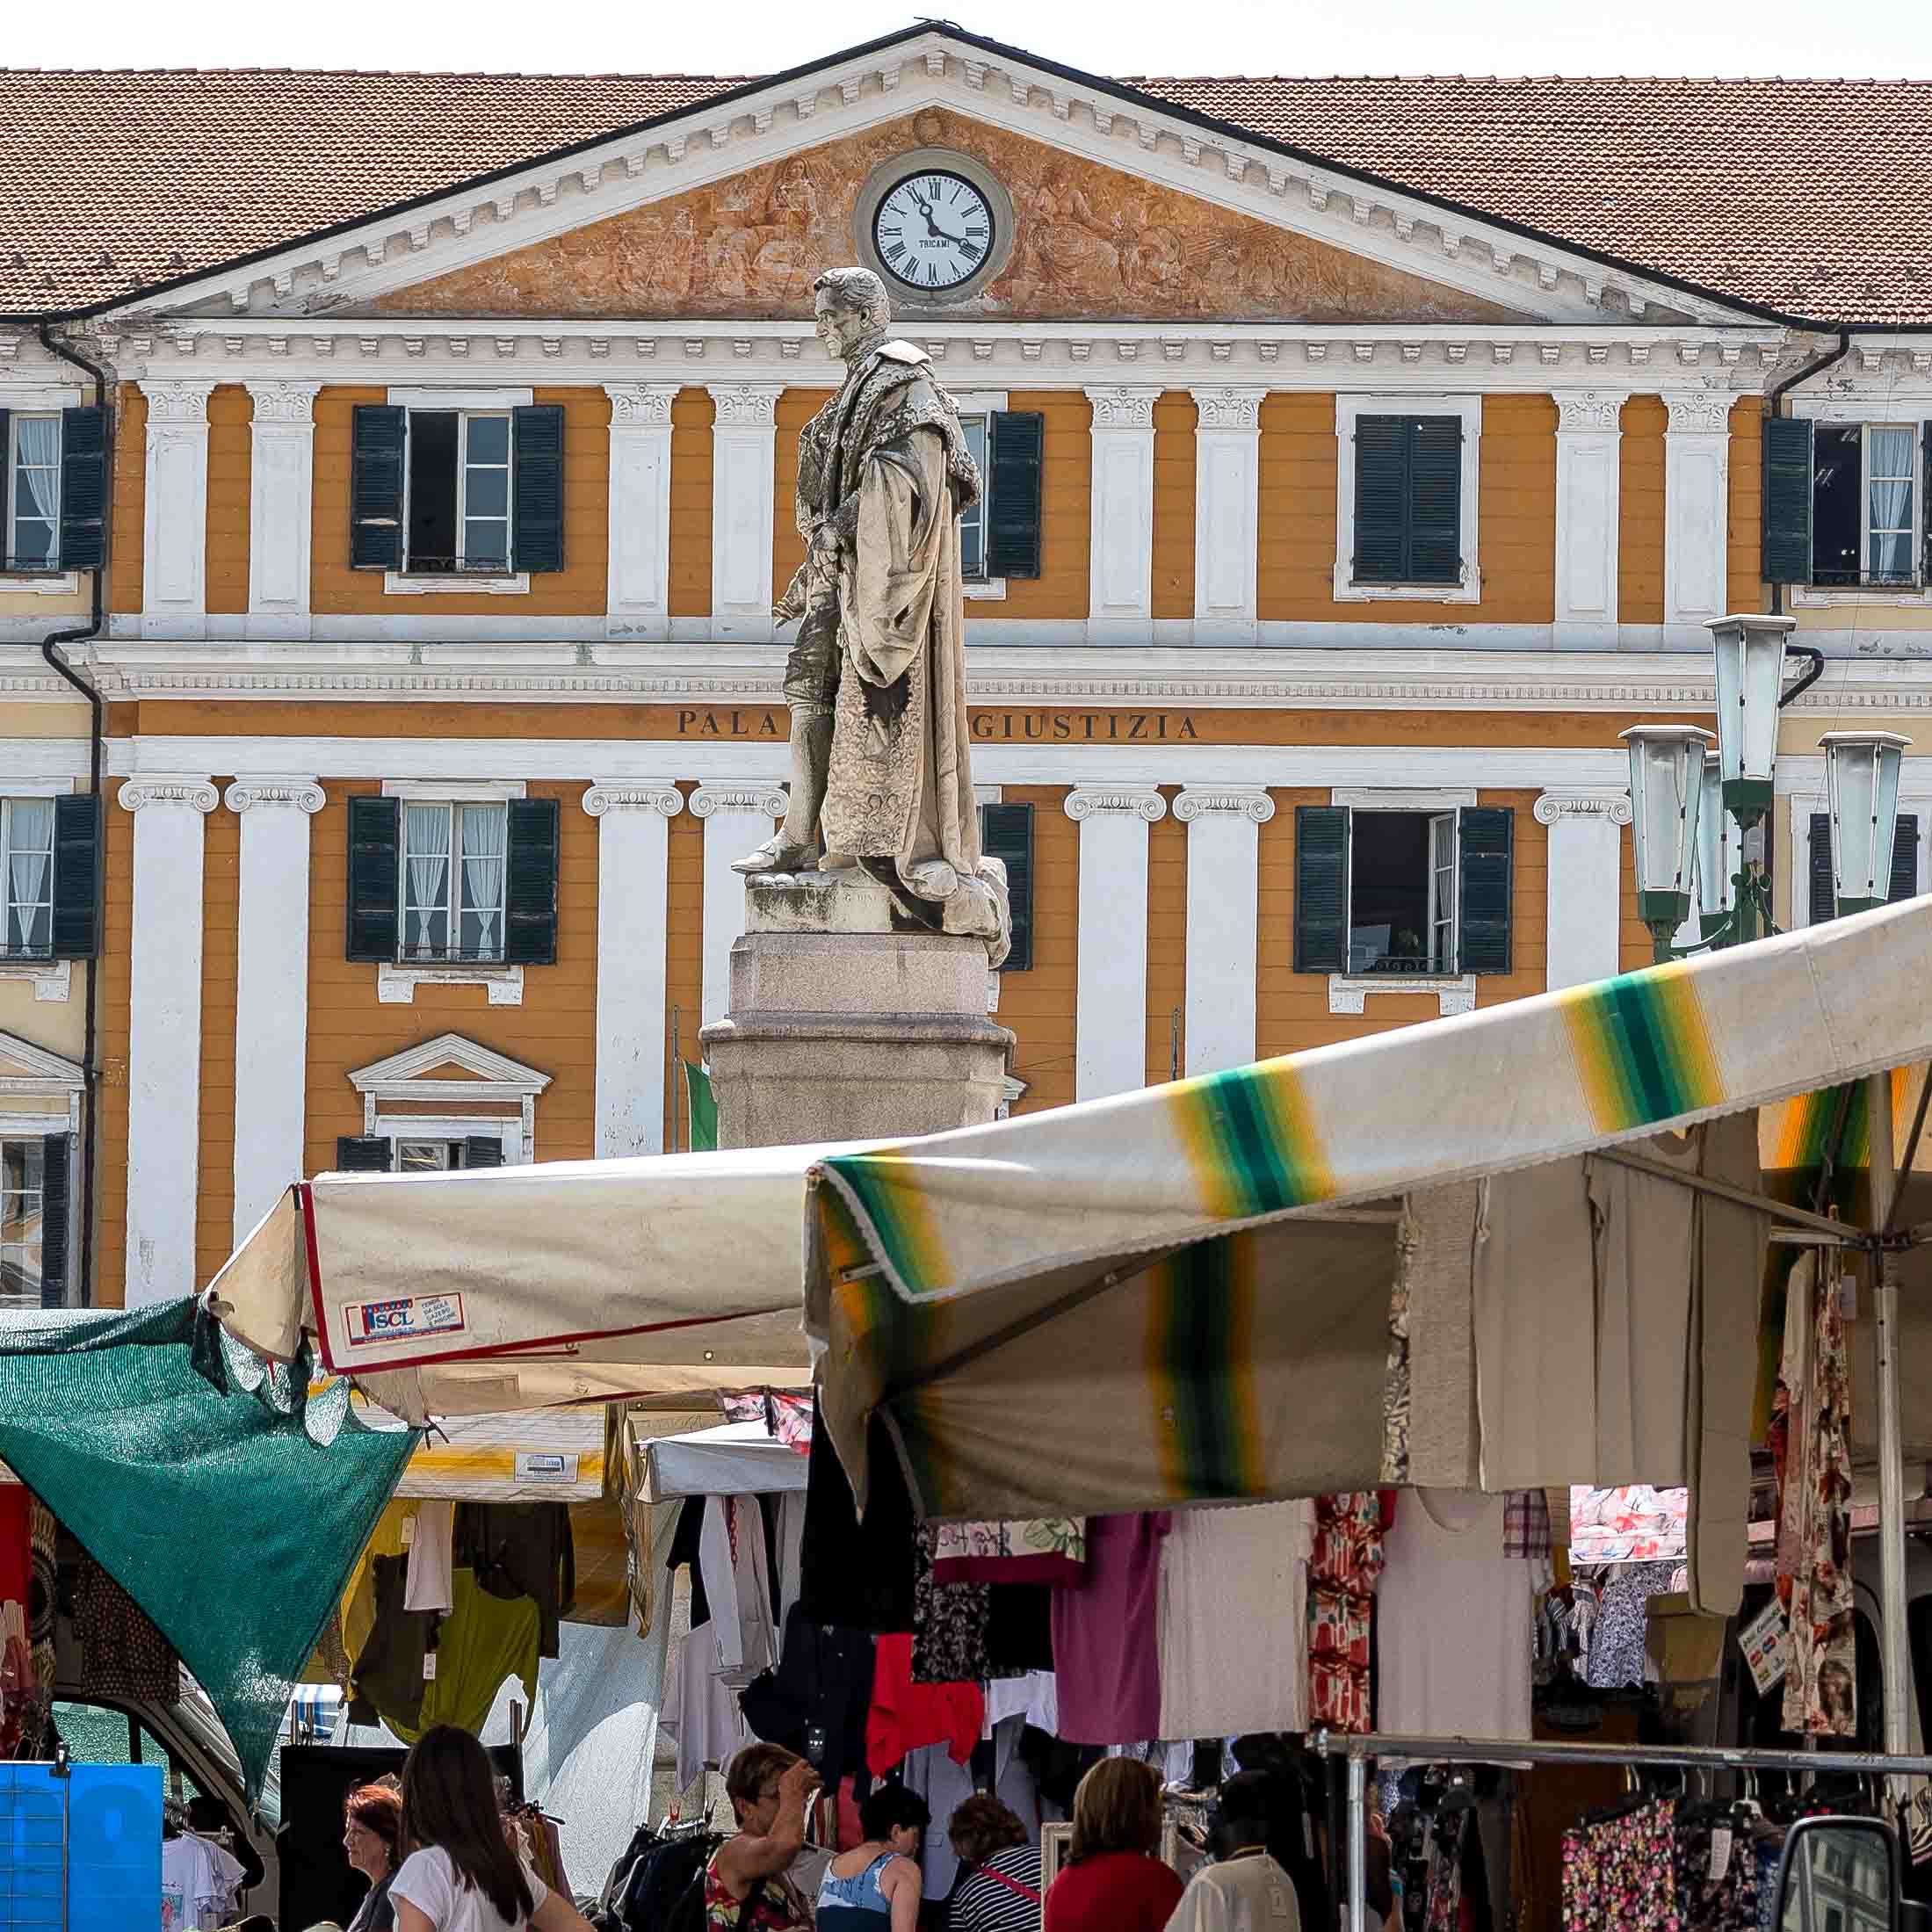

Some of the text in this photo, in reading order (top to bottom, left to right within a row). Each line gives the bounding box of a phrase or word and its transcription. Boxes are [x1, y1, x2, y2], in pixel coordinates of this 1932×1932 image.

[929, 182, 941, 201] XII
[890, 204, 908, 218] X
[960, 205, 979, 219] II
[884, 226, 902, 236] IX
[965, 227, 985, 237] III
[972, 713, 1199, 739] GIUSTIZIA
